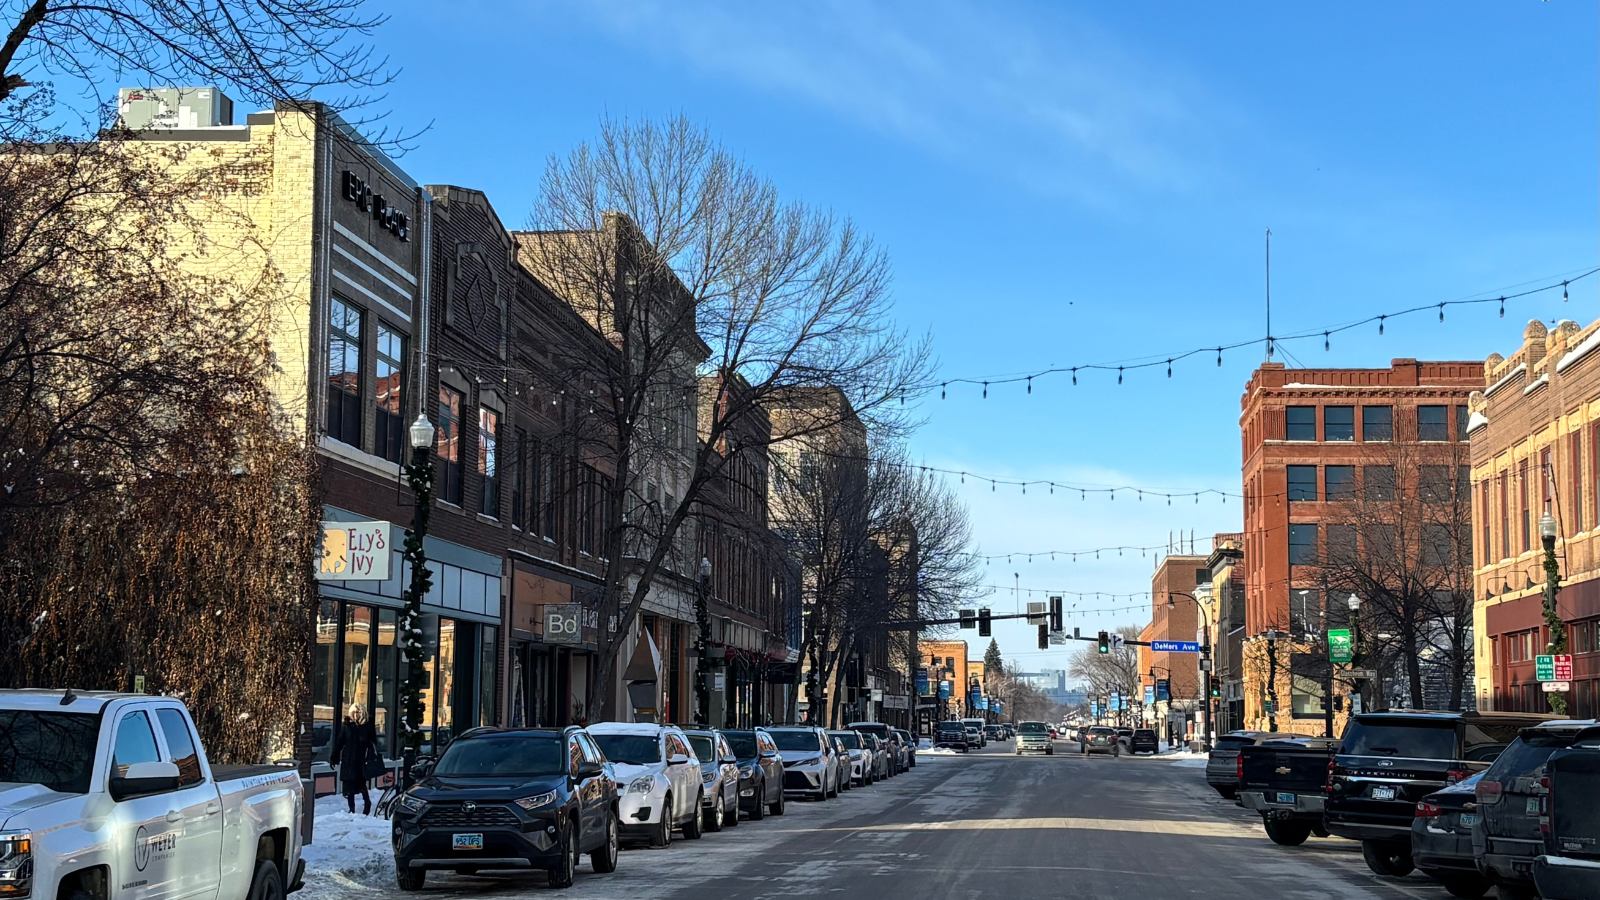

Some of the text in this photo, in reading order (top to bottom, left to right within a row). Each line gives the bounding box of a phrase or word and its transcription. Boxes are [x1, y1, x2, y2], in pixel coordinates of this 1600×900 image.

[342, 170, 411, 243] EPIC PLACE
[549, 614, 577, 634] Bd
[1154, 642, 1196, 651] DeMers Ave
[151, 833, 177, 853] WEYER
